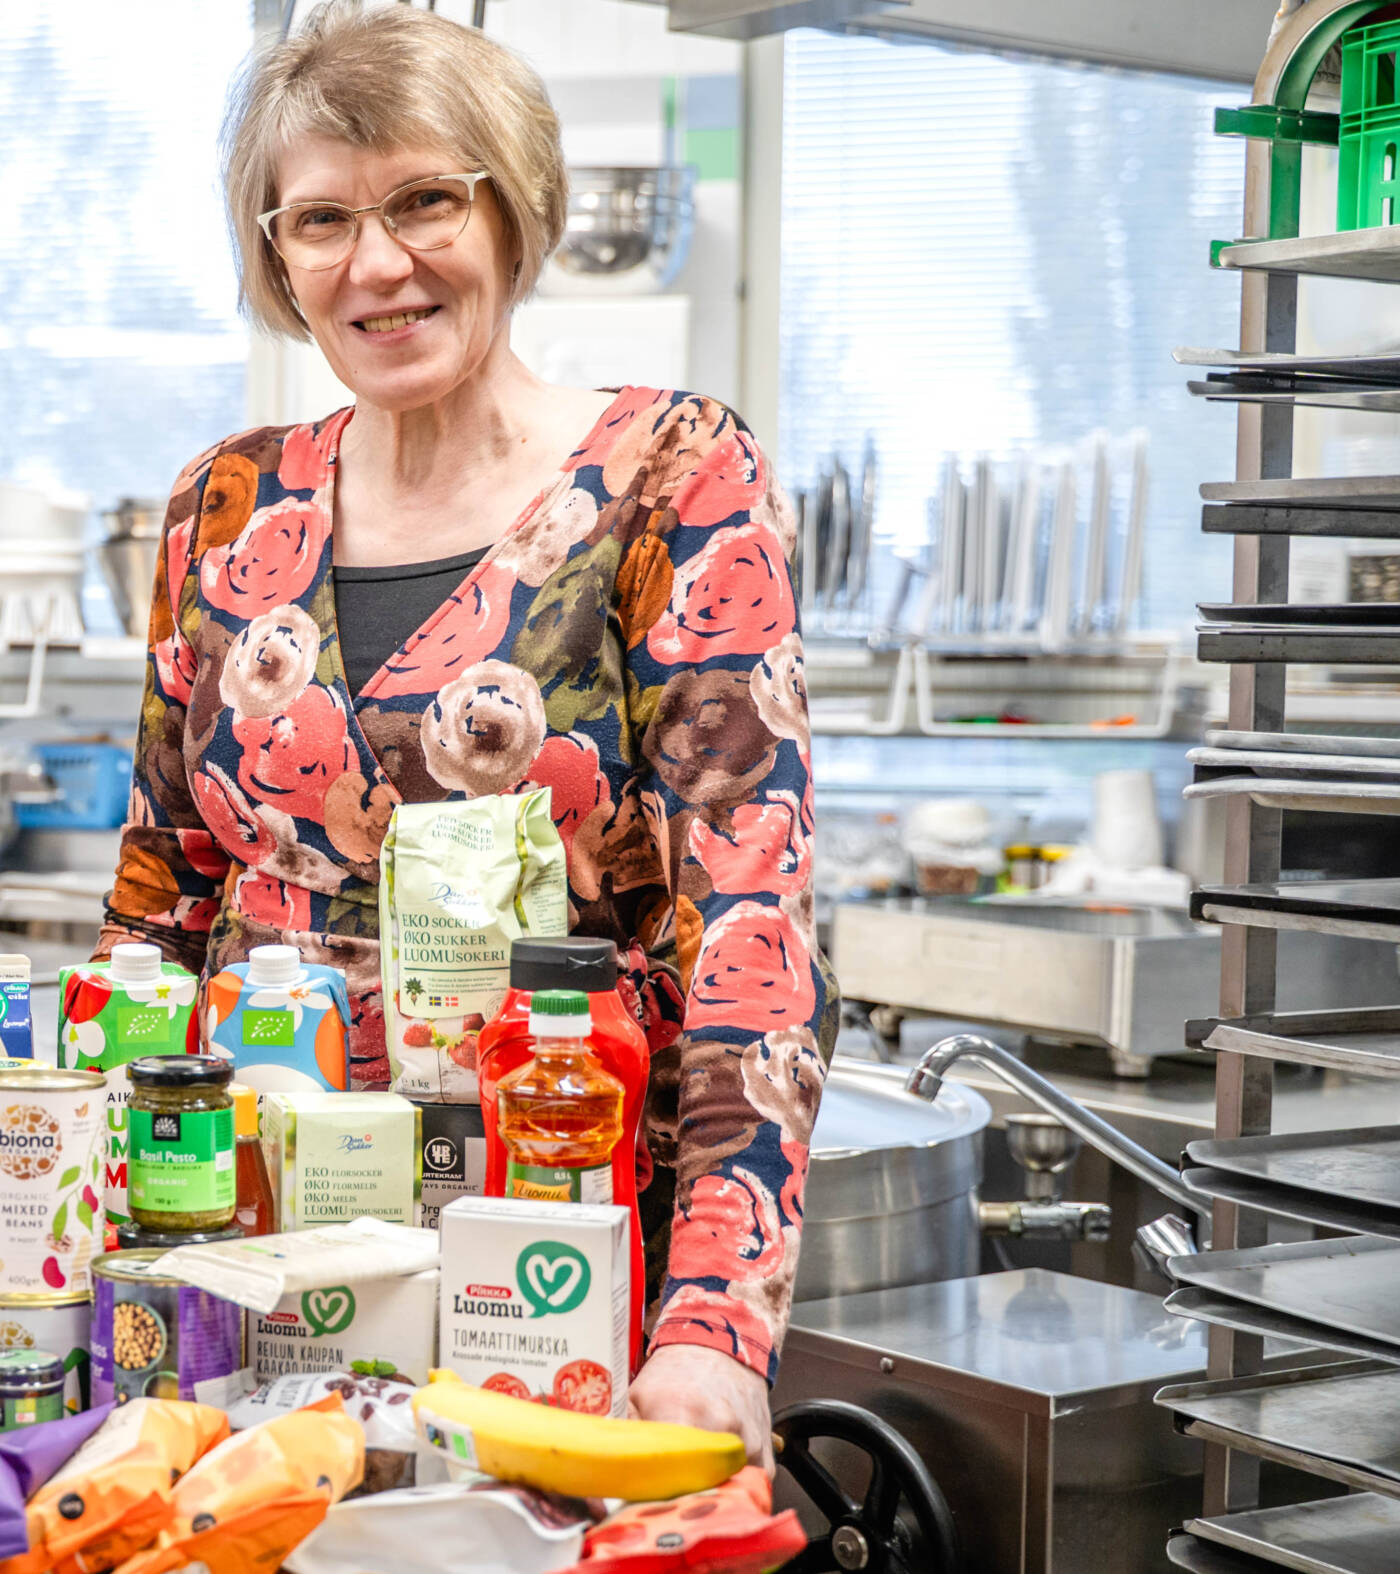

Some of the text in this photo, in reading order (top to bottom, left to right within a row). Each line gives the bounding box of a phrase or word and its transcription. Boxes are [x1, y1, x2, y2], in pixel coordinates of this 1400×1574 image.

[402, 913, 429, 928] EKO
[404, 930, 487, 946] ØKO SUKKER
[139, 1148, 198, 1162] Basil Pesto
[305, 1168, 383, 1177] EKO FLORSOCKER
[304, 1180, 377, 1190] ØKO FLORMELIS
[518, 1183, 563, 1200] Luomu
[0, 1193, 49, 1201] ORGANIC
[304, 1193, 357, 1203] ØKO MELIS
[1, 1204, 48, 1217] MIXED
[304, 1205, 403, 1216] LUOMU TOMUSOKERI
[5, 1219, 44, 1229] BEANS
[454, 1295, 523, 1319] Luomu
[257, 1319, 307, 1337] Luomu
[453, 1328, 569, 1357] TOMAATTIMURSKA
[257, 1340, 343, 1364] REILUN KAUPAN
